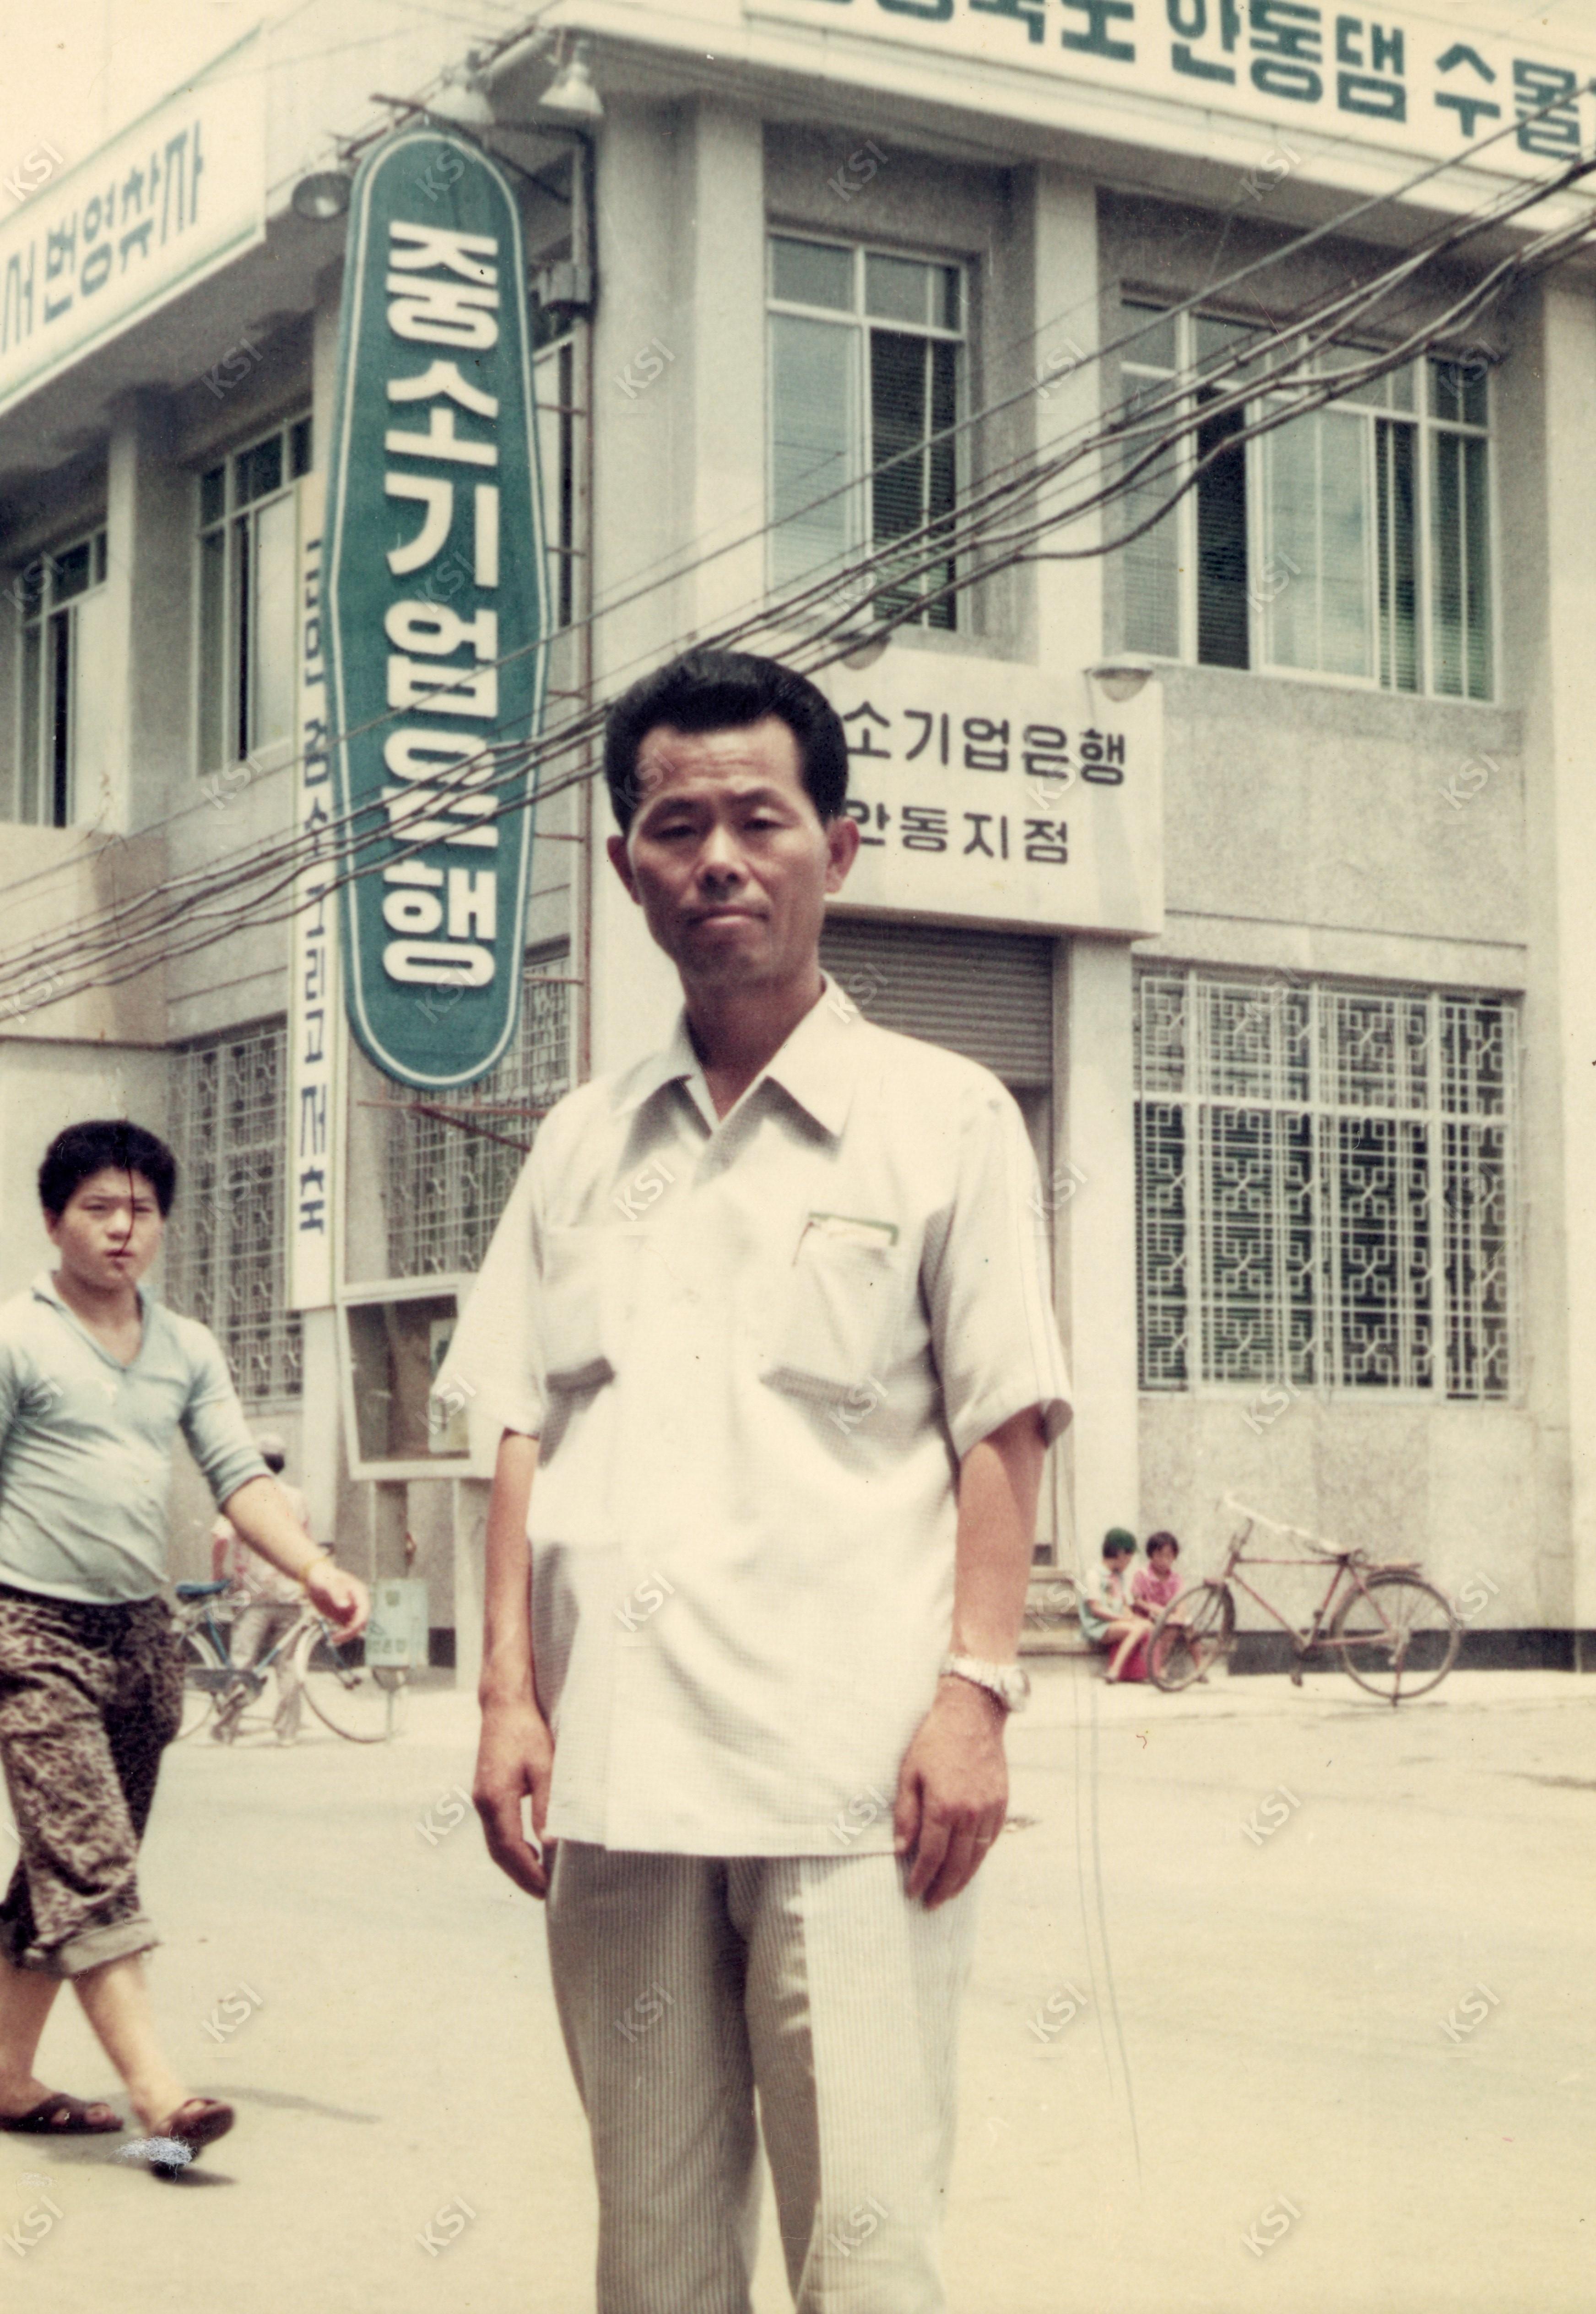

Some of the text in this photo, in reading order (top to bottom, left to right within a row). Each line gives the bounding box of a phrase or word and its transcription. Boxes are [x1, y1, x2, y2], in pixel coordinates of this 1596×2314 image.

[1167, 0, 1407, 124] 안동댐
[1434, 43, 1596, 161] 수몰
[382, 220, 499, 987] 중소기업은행
[304, 884, 325, 1064] 그리고
[299, 1083, 326, 1235] 저축
